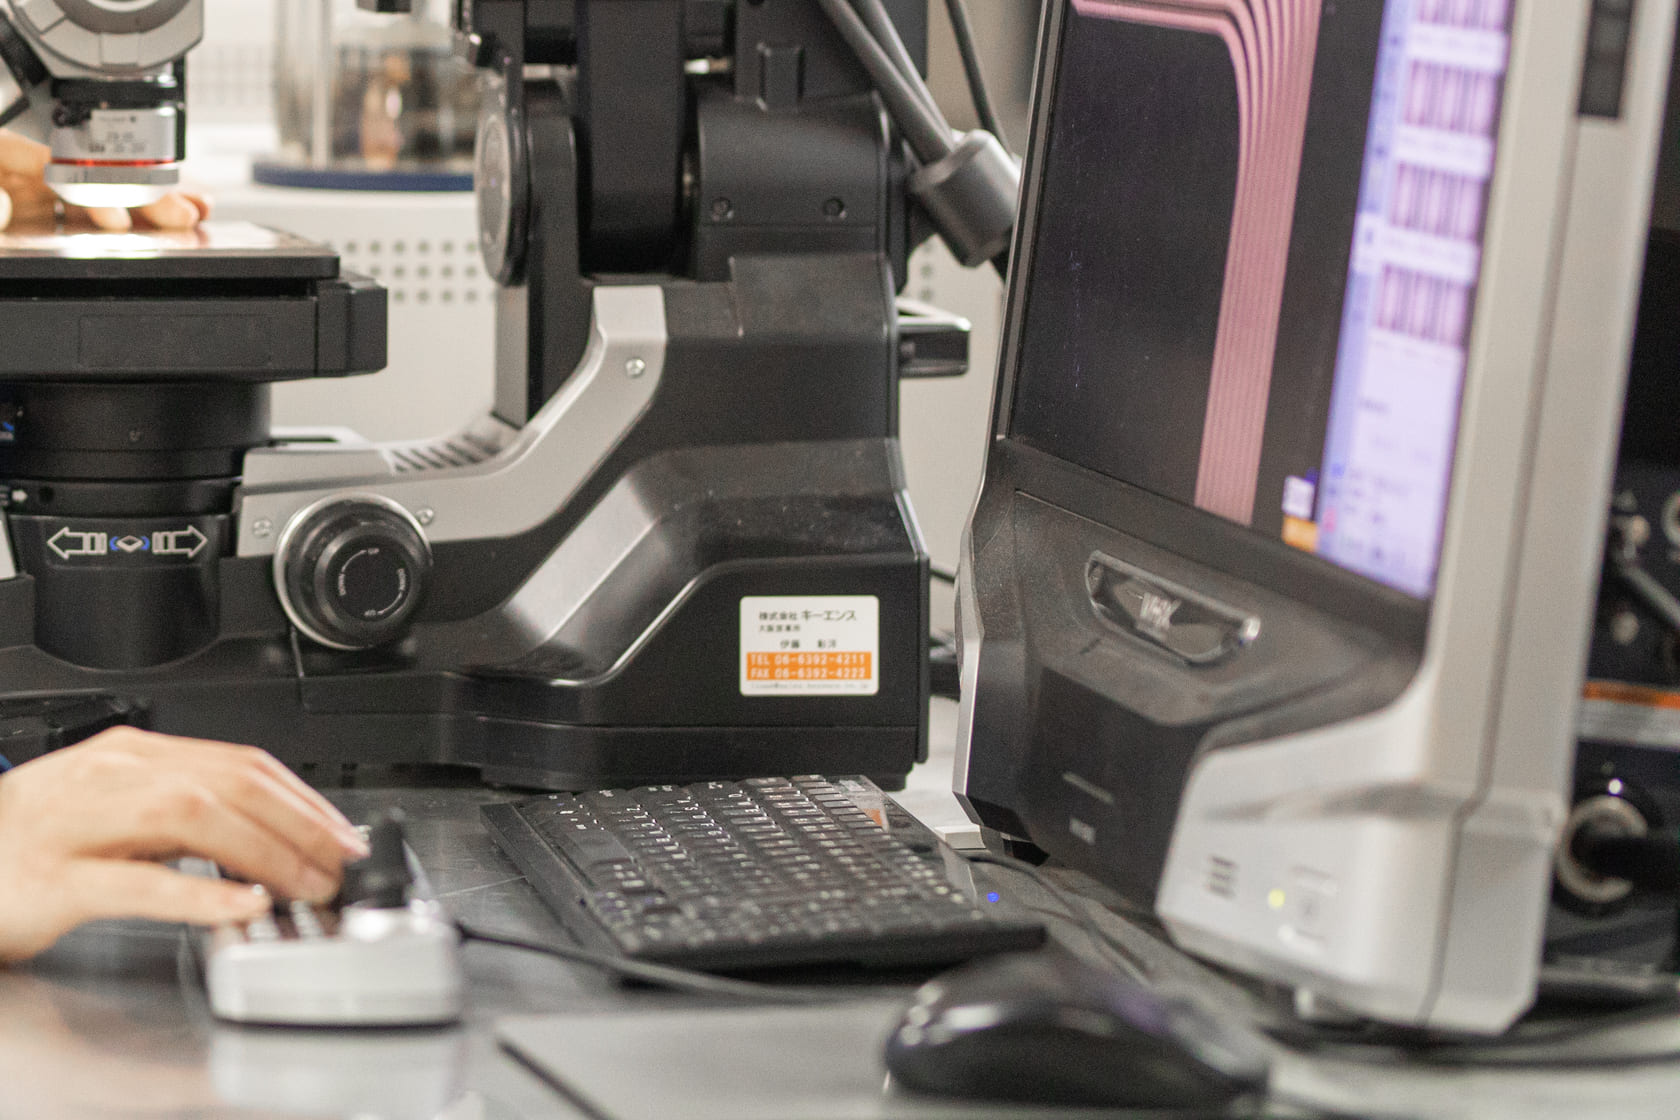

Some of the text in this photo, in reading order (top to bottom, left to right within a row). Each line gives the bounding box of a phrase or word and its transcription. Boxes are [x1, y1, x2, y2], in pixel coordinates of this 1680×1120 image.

[801, 610, 857, 622] キーエンス
[750, 654, 770, 665] TEL
[750, 667, 770, 678] FAX
